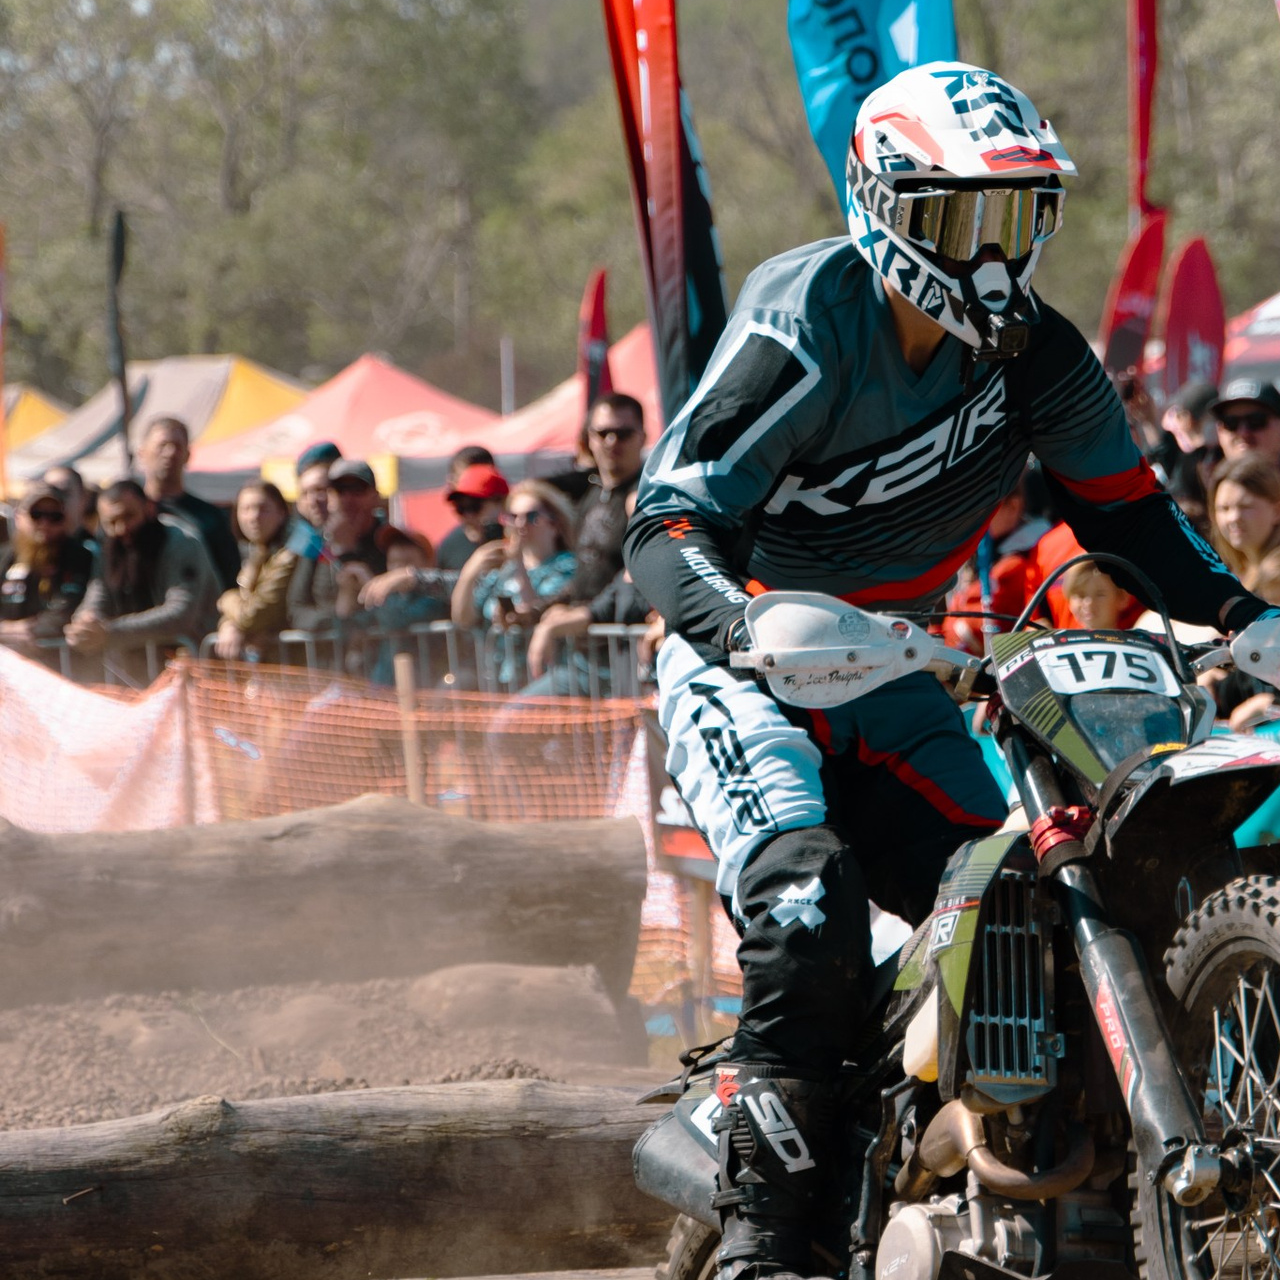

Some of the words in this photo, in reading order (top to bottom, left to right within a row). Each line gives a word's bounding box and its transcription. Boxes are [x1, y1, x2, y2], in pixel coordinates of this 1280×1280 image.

[763, 371, 1006, 516] K2R
[1057, 651, 1157, 684] 175
[1099, 1003, 1121, 1049] PRO
